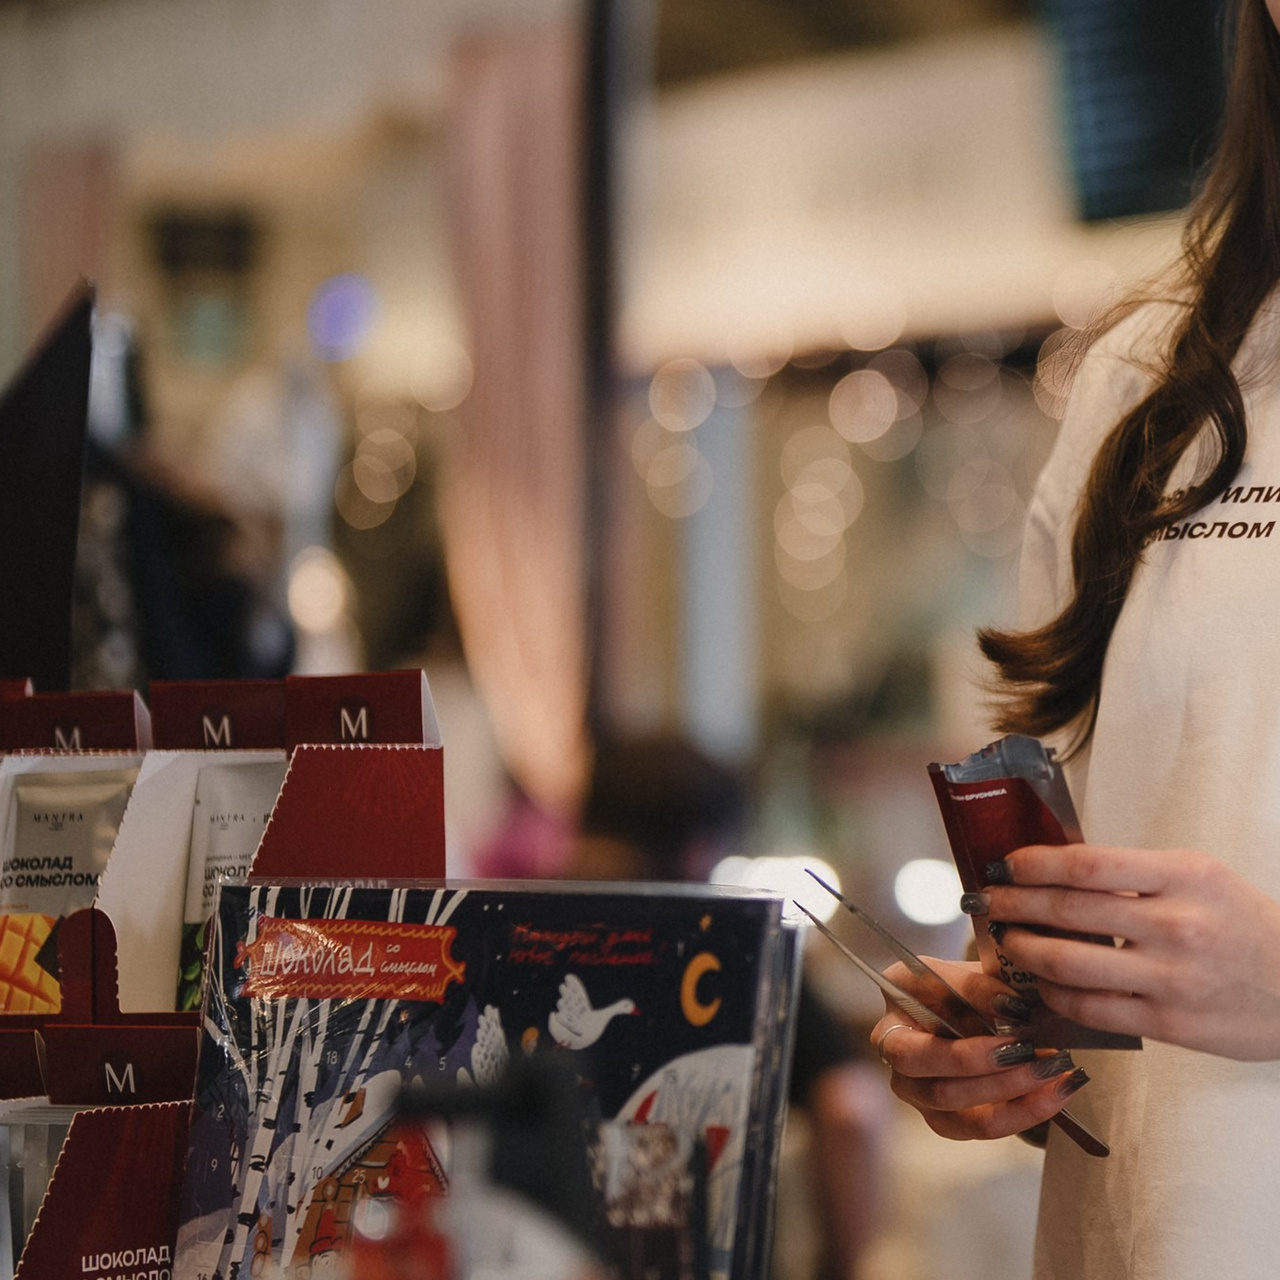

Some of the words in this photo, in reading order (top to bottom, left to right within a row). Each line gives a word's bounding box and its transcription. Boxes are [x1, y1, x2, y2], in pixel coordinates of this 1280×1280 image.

[340, 706, 367, 739] M
[203, 715, 231, 746] M
[326, 1050, 338, 1065] 18
[404, 1055, 412, 1068] 4
[438, 1058, 447, 1071] 5
[104, 1062, 136, 1093] M
[217, 1104, 225, 1119] 2
[210, 1158, 218, 1171] 9
[311, 1166, 323, 1180] 10
[352, 1170, 366, 1184] 25
[82, 1245, 171, 1272] ШОКОЛАД
